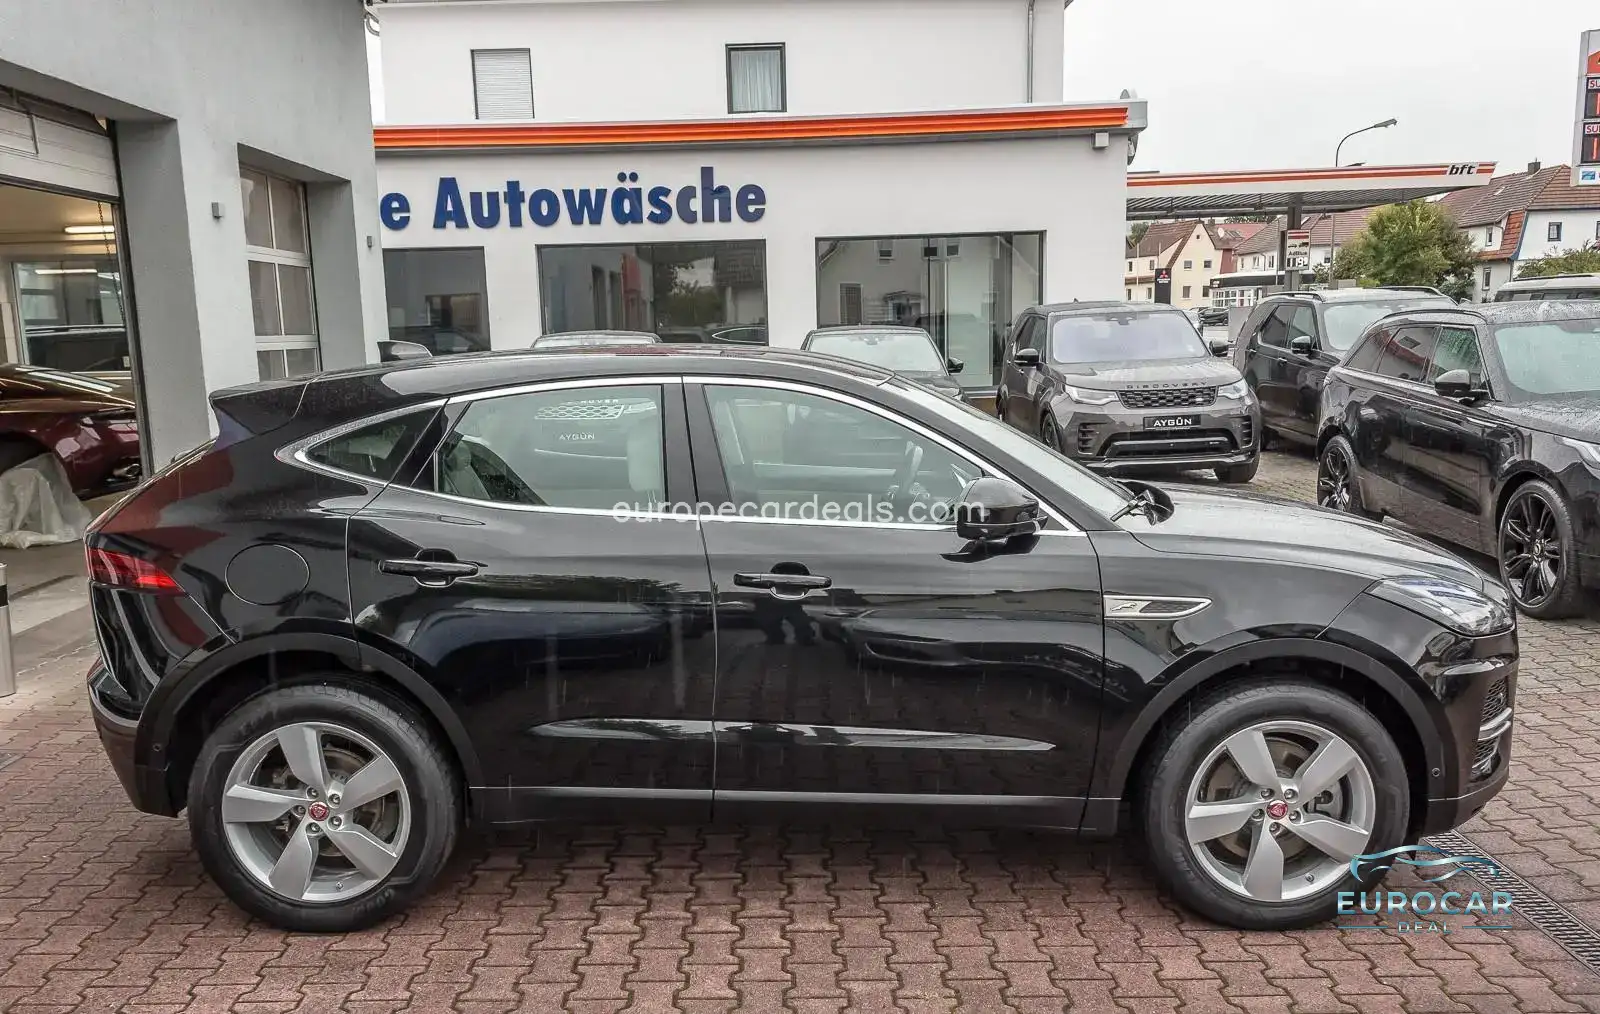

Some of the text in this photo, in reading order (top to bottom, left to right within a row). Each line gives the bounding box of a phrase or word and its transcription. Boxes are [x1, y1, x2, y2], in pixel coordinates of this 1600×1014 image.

[1587, 125, 1600, 133] SU
[1449, 164, 1475, 175] bft
[380, 166, 767, 231] e Autowäsche
[1153, 417, 1192, 427] AYGÜN
